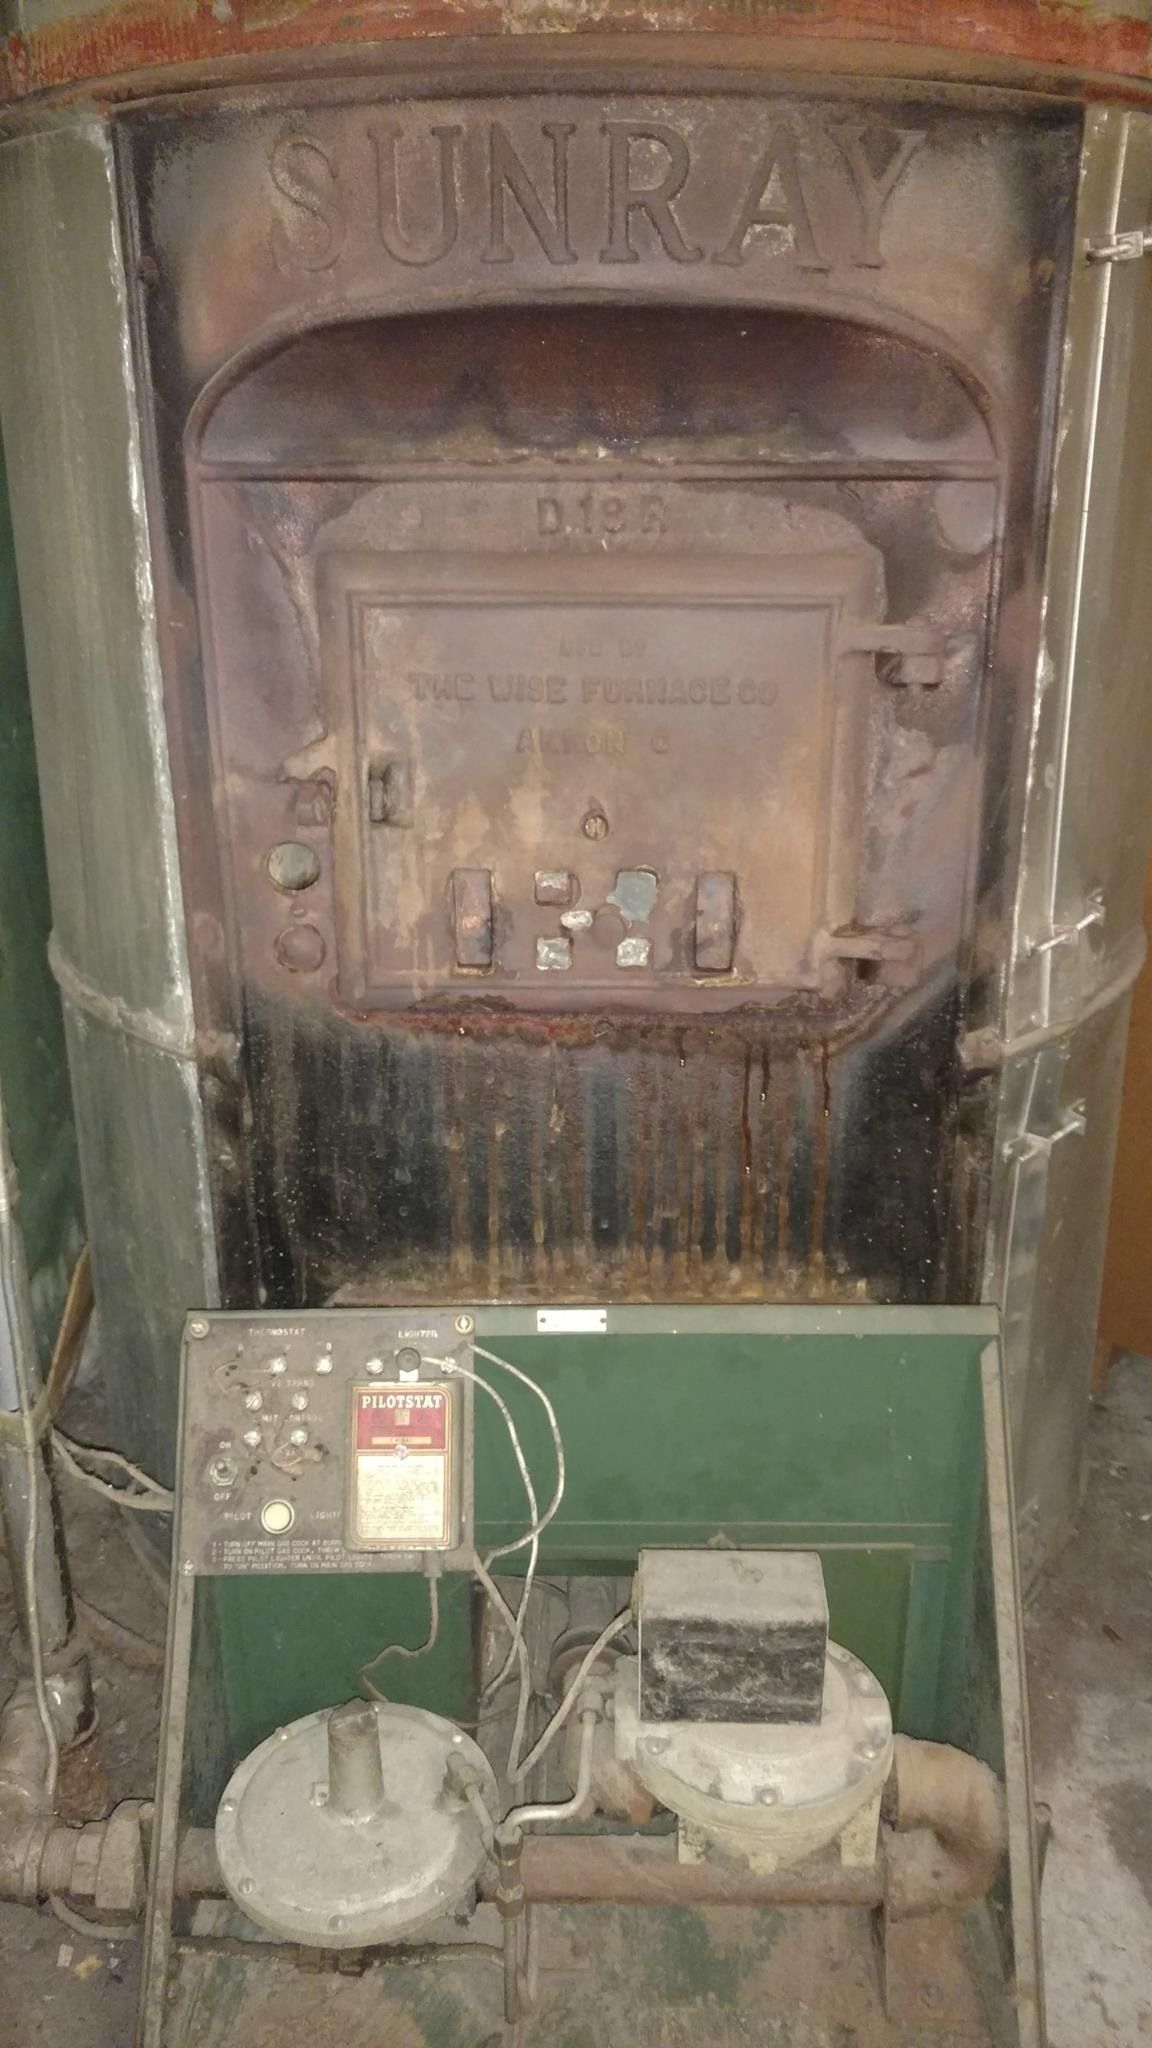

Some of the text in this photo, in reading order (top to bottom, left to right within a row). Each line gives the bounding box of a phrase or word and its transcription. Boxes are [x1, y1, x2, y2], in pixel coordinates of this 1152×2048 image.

[267, 121, 928, 274] SUNRAY
[408, 672, 475, 703] THE
[487, 674, 568, 705] WISE
[581, 675, 731, 706] FURNACE
[398, 1330, 438, 1338] LIGHTER
[361, 1395, 443, 1408] PILOTSTAT
[219, 1441, 231, 1449] ON
[213, 1492, 231, 1501] OFF
[224, 1512, 252, 1520] PILOT
